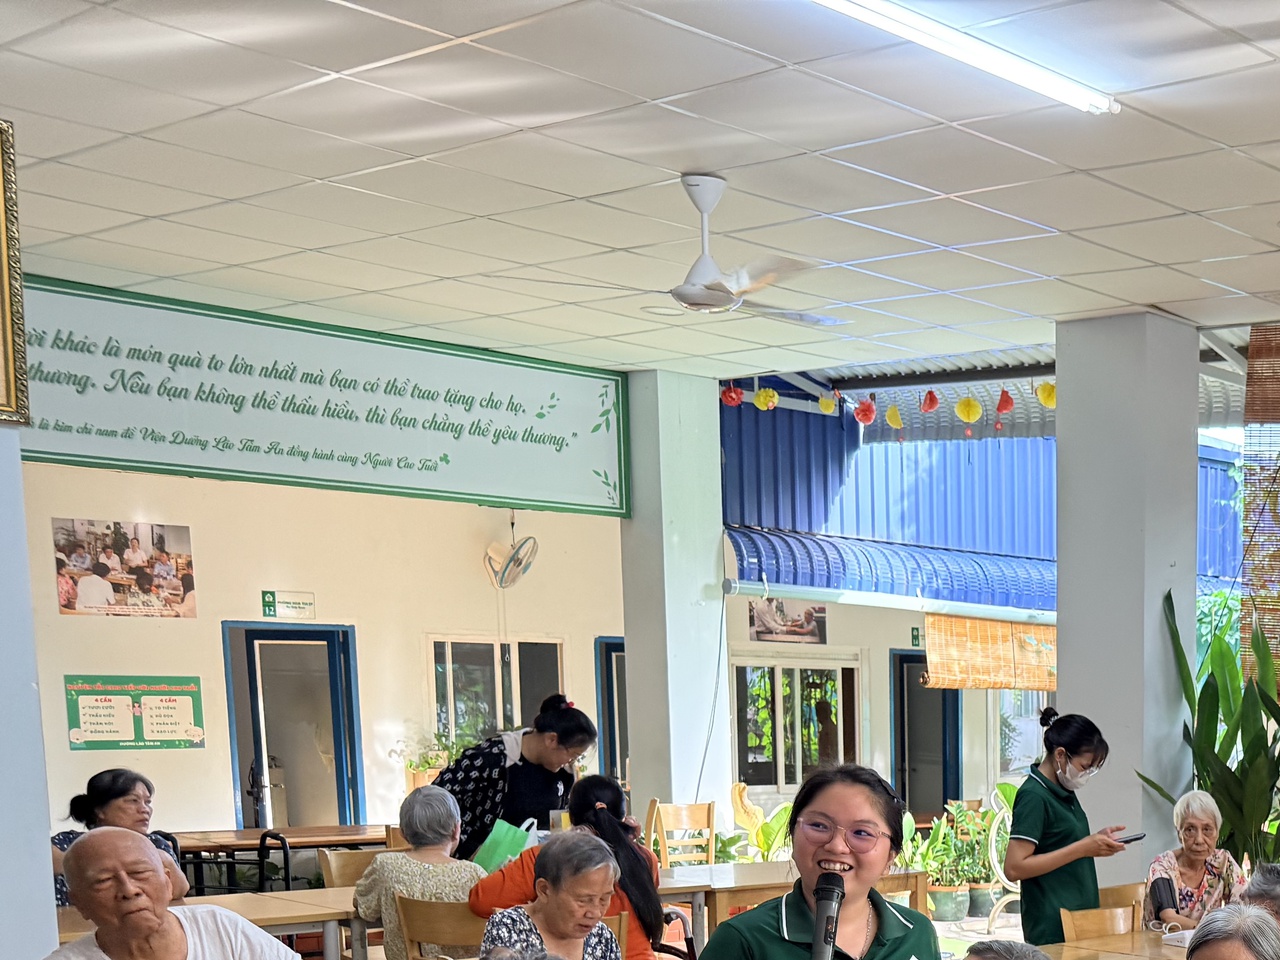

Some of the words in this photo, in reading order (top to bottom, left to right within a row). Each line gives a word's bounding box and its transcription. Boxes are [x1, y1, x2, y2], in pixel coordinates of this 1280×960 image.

[50, 329, 98, 354] khác
[102, 336, 121, 357] là
[126, 344, 162, 363] món
[167, 351, 202, 372] quà
[207, 354, 224, 371] to
[228, 354, 254, 375] lớn
[258, 360, 297, 381] nhất
[300, 369, 325, 385] mà
[329, 369, 358, 392] bạn
[362, 378, 380, 393] có
[383, 378, 410, 397] thể
[410, 383, 440, 401] trao
[443, 388, 475, 412] tặng
[479, 391, 503, 410] cho
[505, 394, 526, 416] họ.
[157, 377, 190, 401] bạn
[194, 382, 246, 413] không
[251, 390, 280, 411] thể
[281, 394, 319, 416] thấu
[321, 399, 359, 421] hiểu,
[365, 405, 387, 424] thì
[390, 408, 418, 430] bạn
[421, 413, 464, 440] chẳng
[468, 419, 493, 438] thể
[491, 425, 519, 445] yêu
[53, 419, 73, 433] kim
[95, 427, 118, 438] nam
[140, 427, 166, 444] Viện
[169, 431, 209, 450] Dưỡng
[212, 436, 235, 451] Lão
[237, 438, 261, 453] Tâm
[263, 441, 284, 455] An
[286, 445, 309, 461] đồng
[312, 448, 334, 461] hành
[337, 452, 358, 466] cùng
[361, 452, 393, 469] Người
[397, 456, 415, 469] Cao
[418, 458, 438, 471] Tuổi
[265, 606, 275, 615] 12
